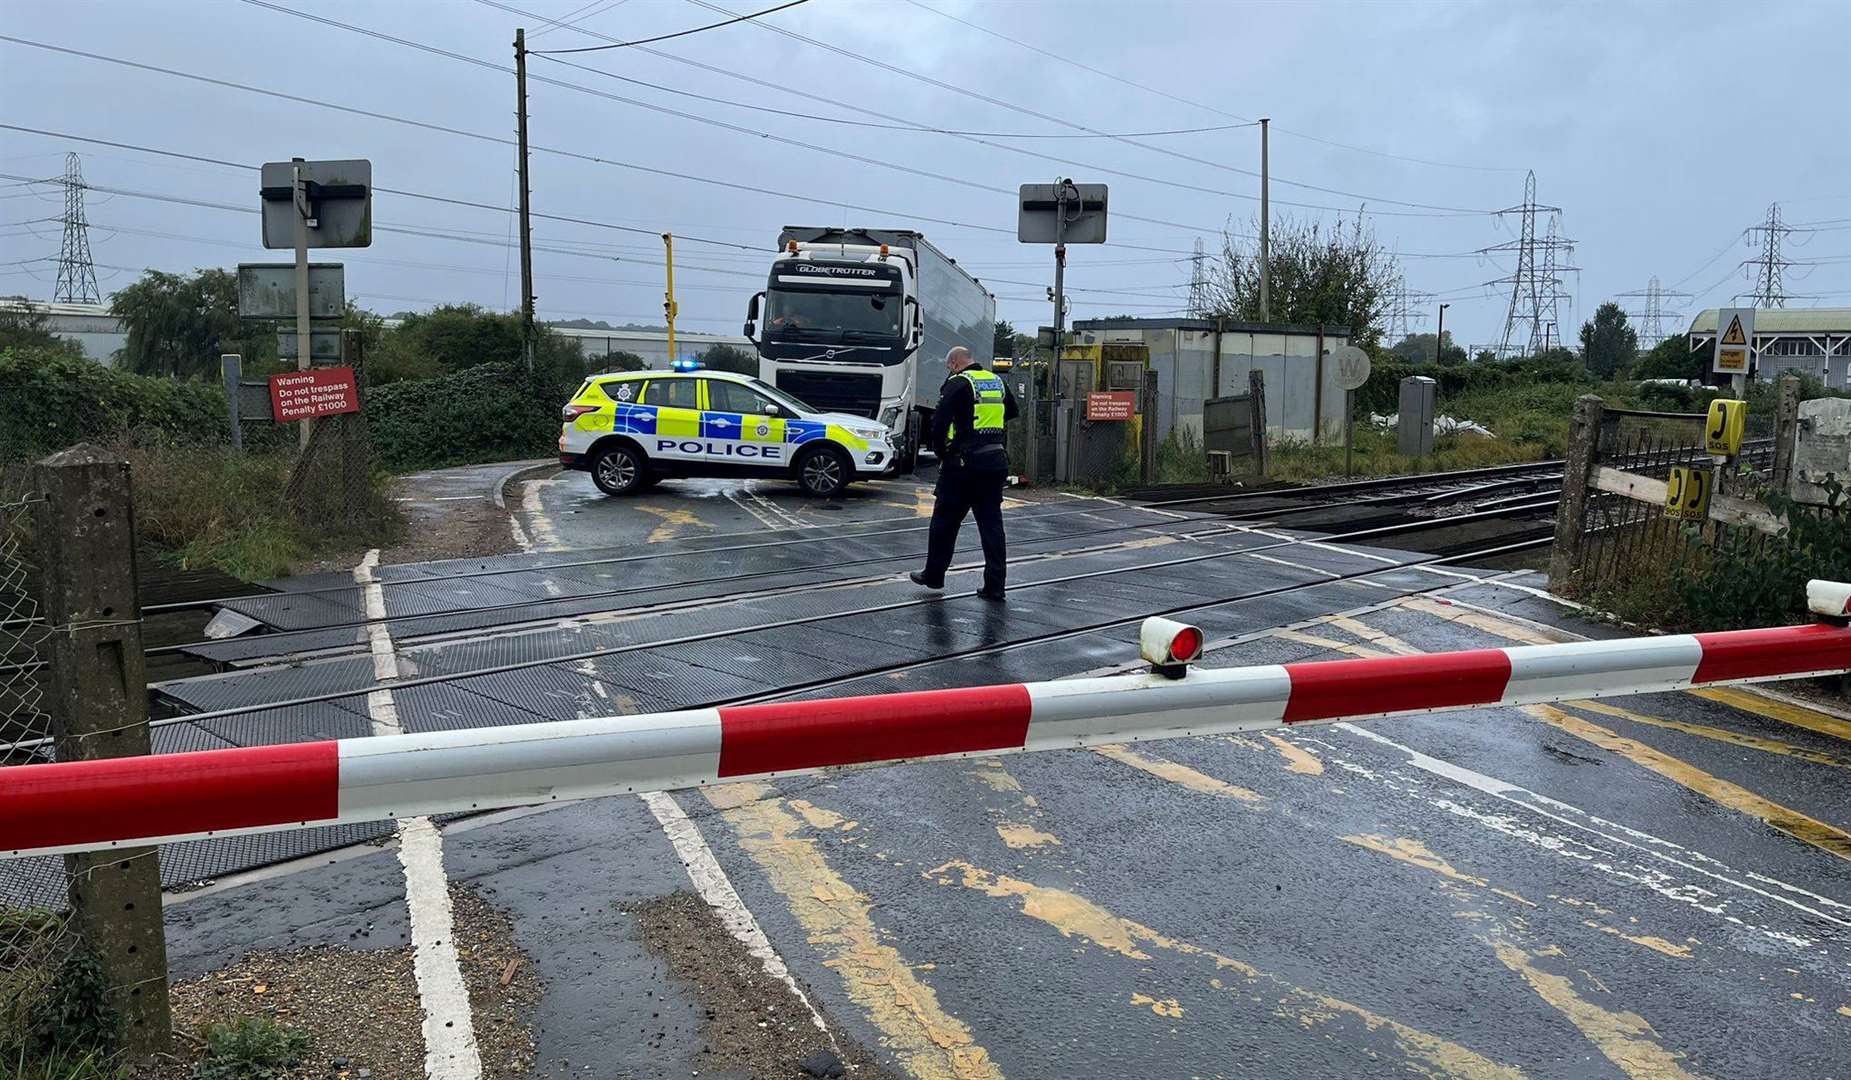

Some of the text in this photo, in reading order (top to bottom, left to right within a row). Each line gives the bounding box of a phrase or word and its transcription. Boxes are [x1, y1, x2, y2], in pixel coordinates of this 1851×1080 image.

[798, 265, 876, 276] GLOBETROTTER
[1338, 358, 1361, 377] W
[276, 376, 315, 386] Warning
[977, 381, 1002, 390] POLICE
[279, 382, 349, 398] Do not trespass
[280, 392, 345, 407] on the Railway
[282, 400, 347, 416] Penalty £1000
[657, 440, 780, 458] POLICE
[1708, 441, 1729, 450] SOS
[1665, 508, 1680, 516] SOS
[1683, 510, 1702, 518] SOS
